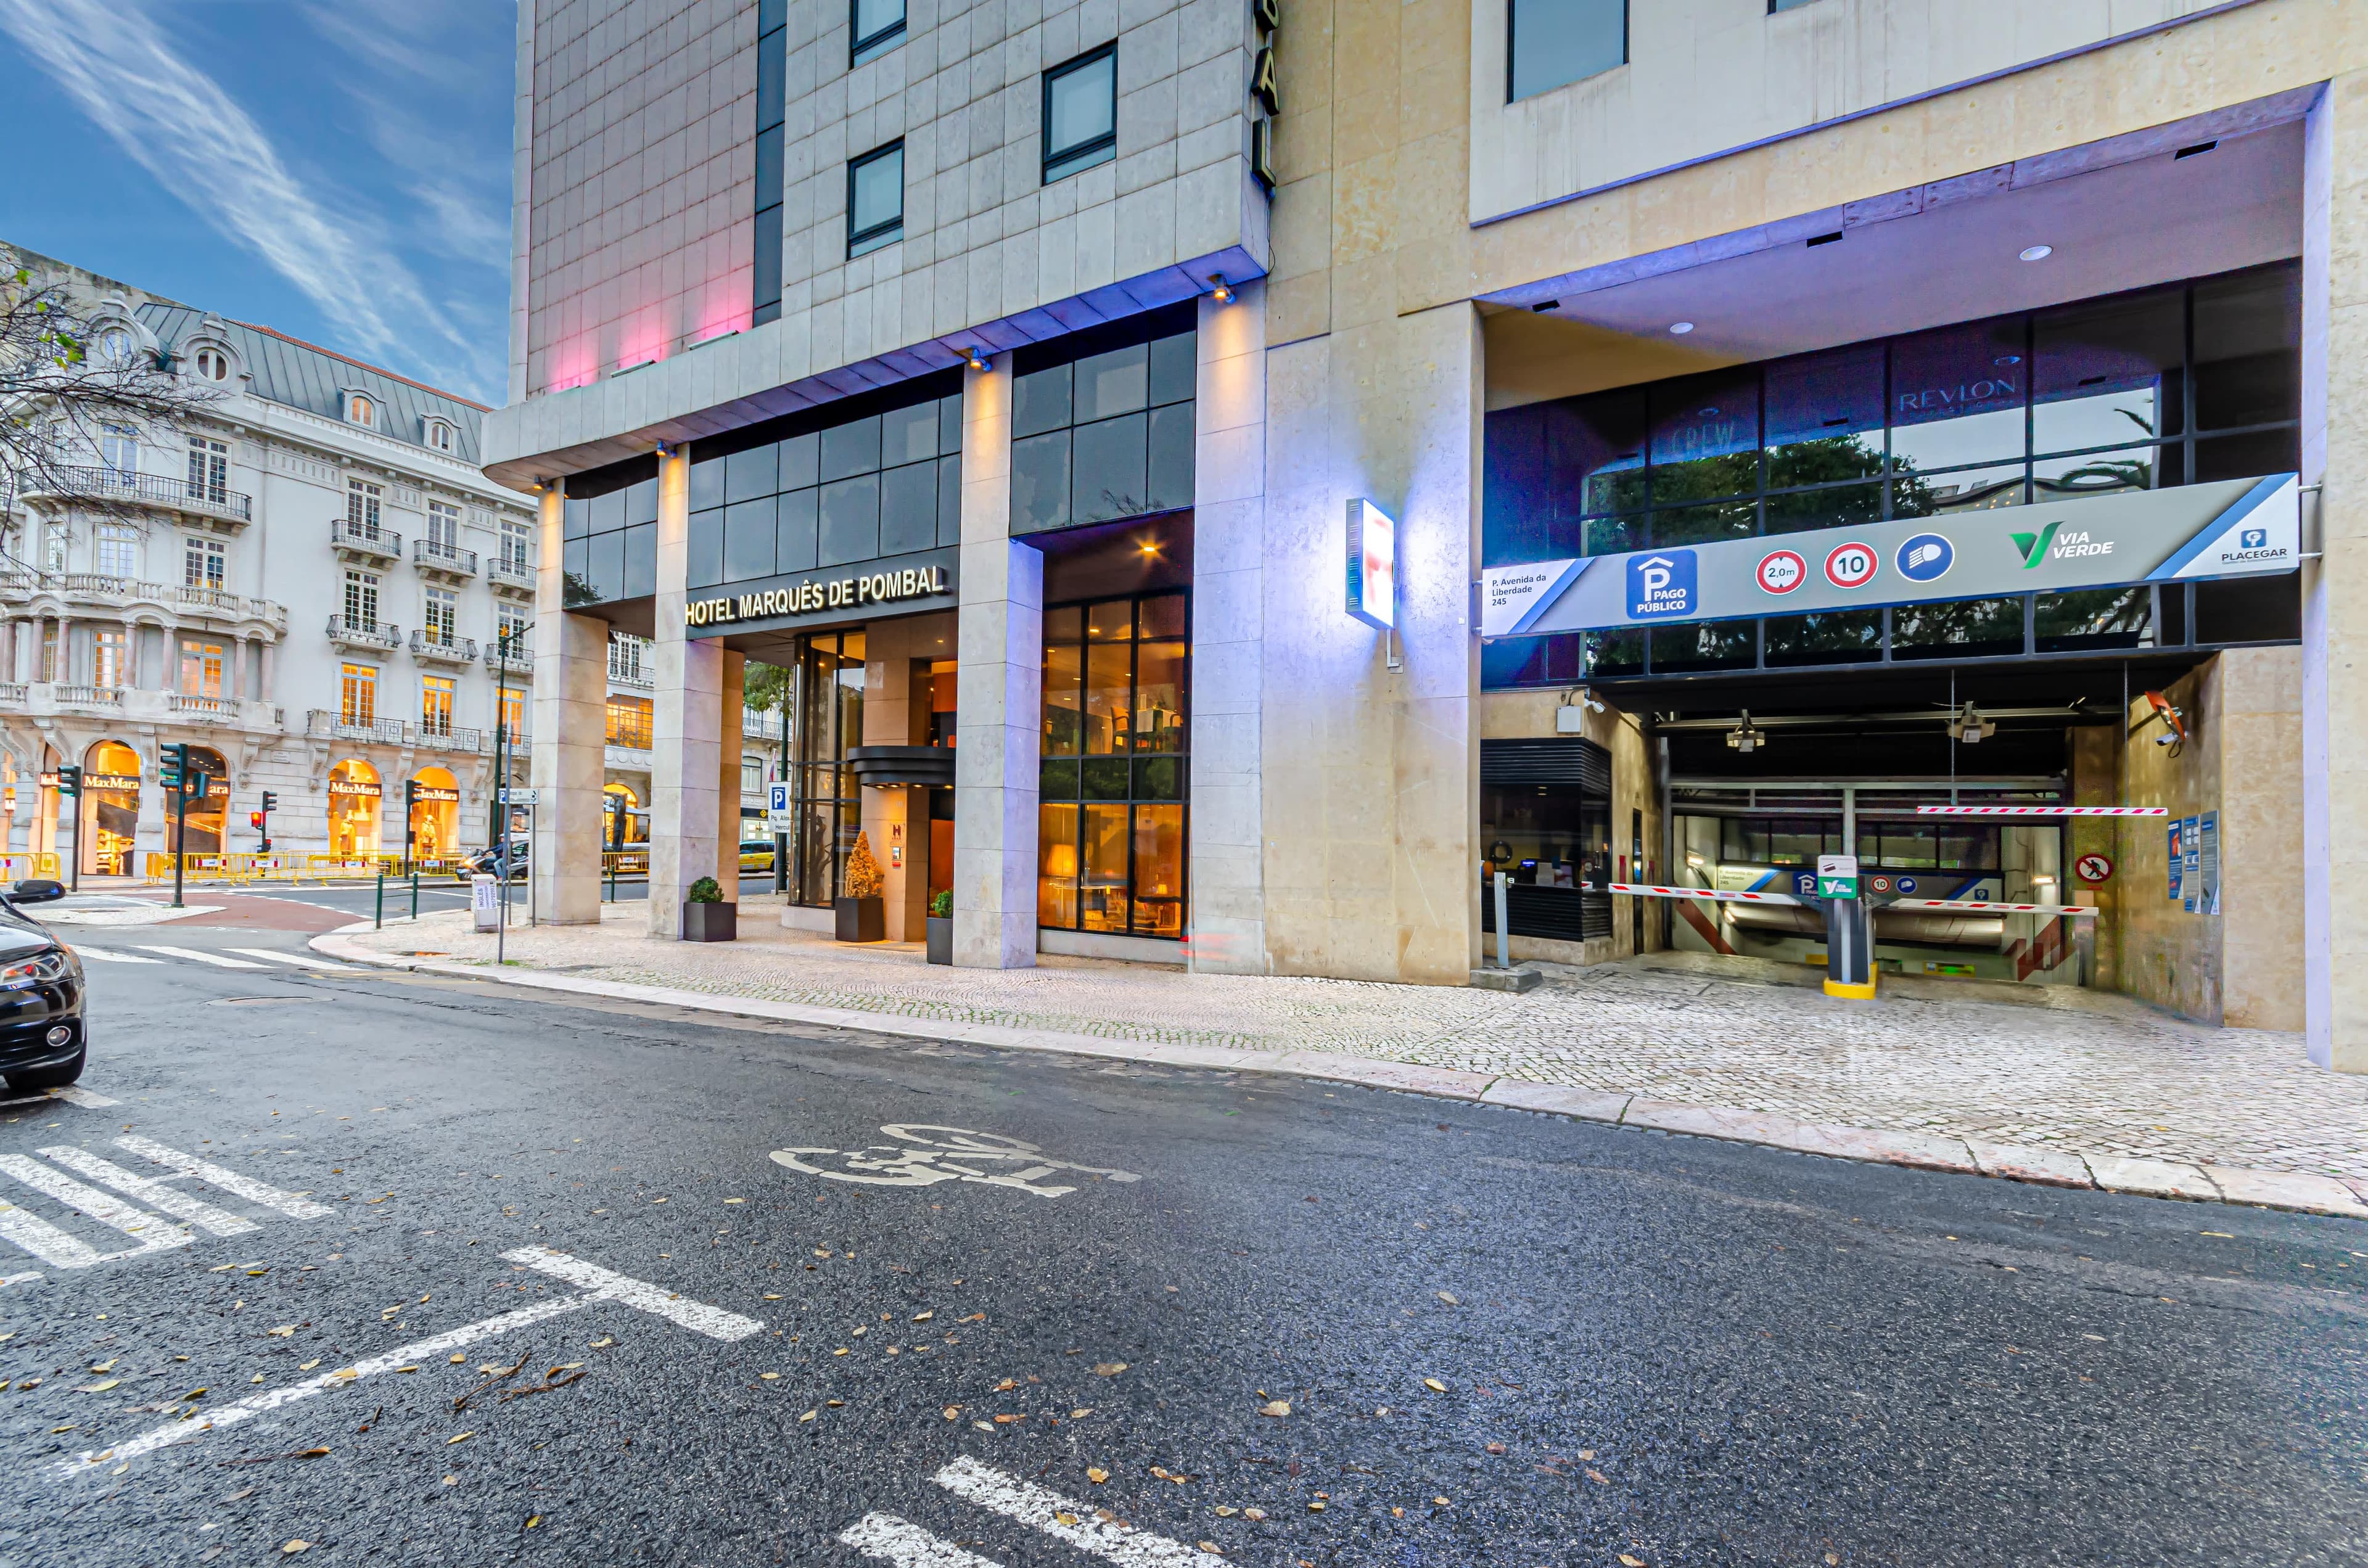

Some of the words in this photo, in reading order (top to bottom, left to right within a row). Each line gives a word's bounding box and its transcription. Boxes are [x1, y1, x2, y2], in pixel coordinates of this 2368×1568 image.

[1899, 376, 2015, 411] REVLON
[2060, 532, 2090, 545] VIA
[2054, 541, 2115, 559] VERDE
[2221, 548, 2287, 561] PLACEGAR
[1838, 556, 1864, 575] 10
[1501, 575, 1534, 585] Avenida
[685, 597, 736, 626] HOTEL
[739, 581, 825, 618] MARQUÊS
[828, 578, 854, 607] DE
[860, 565, 944, 602] POMBAL
[1492, 585, 1532, 596] Liberdade
[1654, 588, 1687, 600] PAGO
[1492, 597, 1507, 605] 245
[1637, 600, 1687, 613] PÚBLICO
[83, 776, 139, 789] MaxMara
[331, 782, 380, 795] MaxMara
